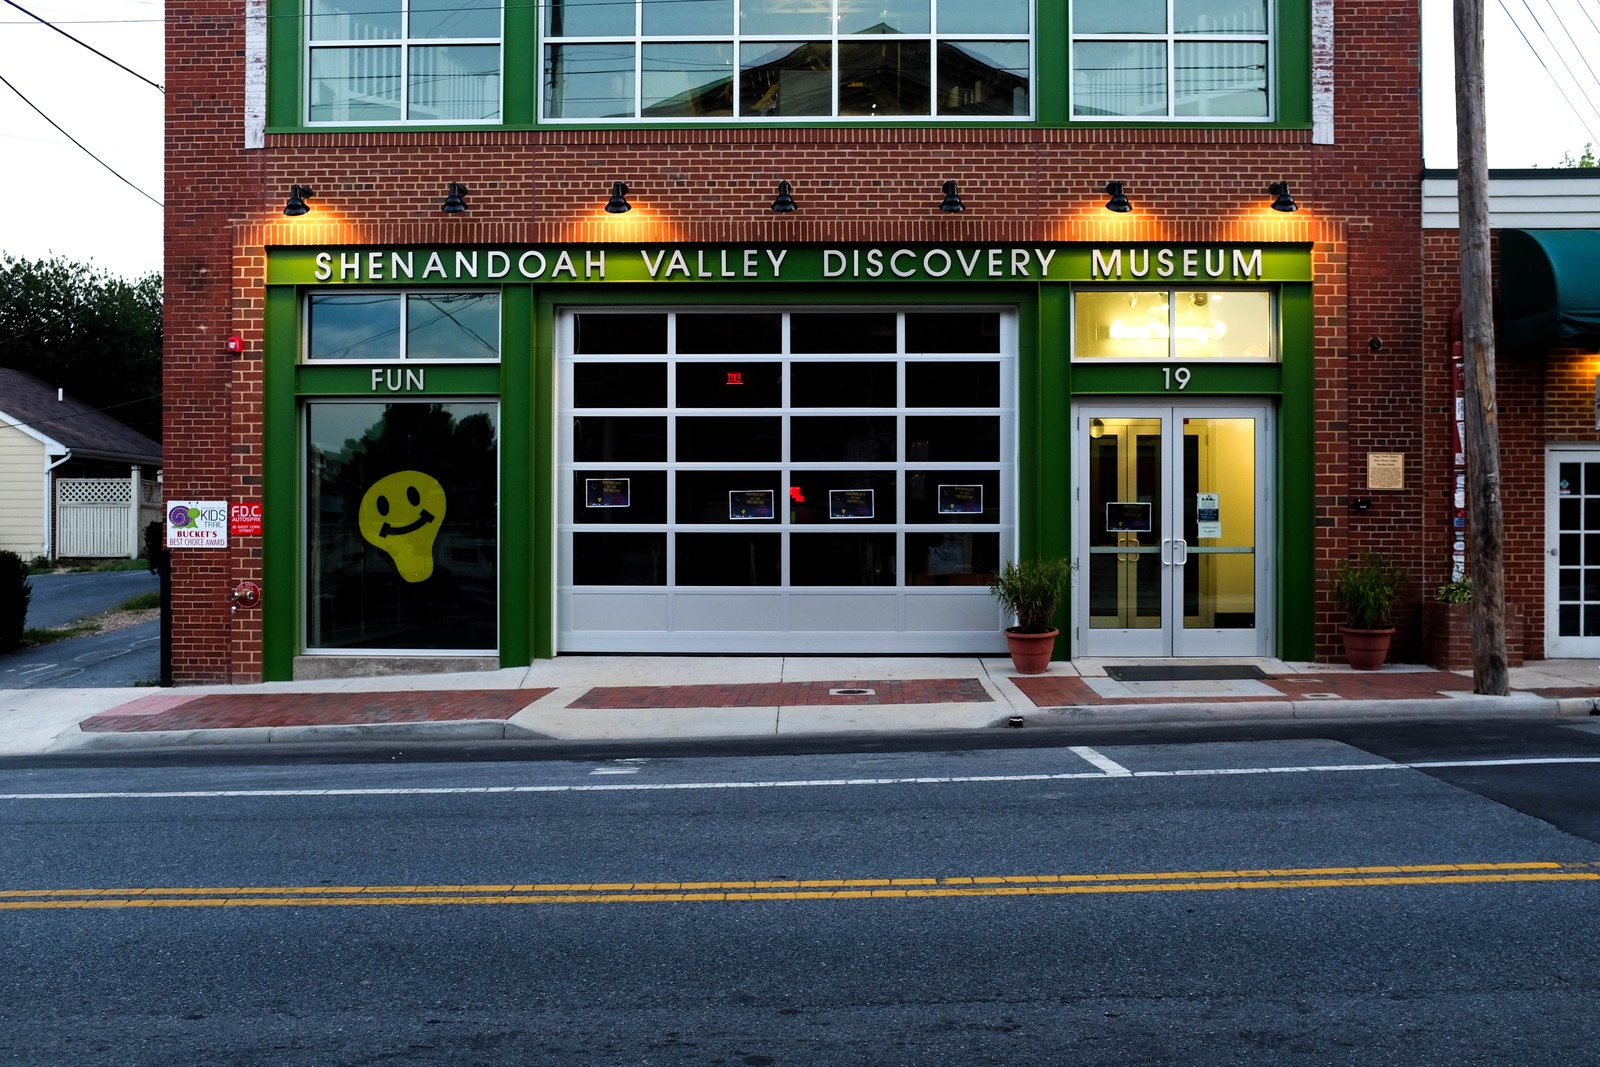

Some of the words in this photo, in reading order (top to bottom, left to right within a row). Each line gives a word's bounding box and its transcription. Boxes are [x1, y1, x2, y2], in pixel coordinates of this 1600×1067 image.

[314, 249, 606, 280] SHENANDOAH
[640, 248, 788, 278] VALLEY
[823, 247, 1057, 278] DISCOVERY
[1092, 247, 1264, 278] MUSEUM
[371, 367, 426, 392] FUN
[1162, 366, 1192, 391] 19
[200, 509, 226, 522] KIDS
[232, 506, 262, 517] F.D.C.
[204, 521, 224, 529] TRAIL
[169, 538, 183, 546] BEST
[184, 538, 204, 546] CHOICE
[205, 538, 225, 546] AWARD
